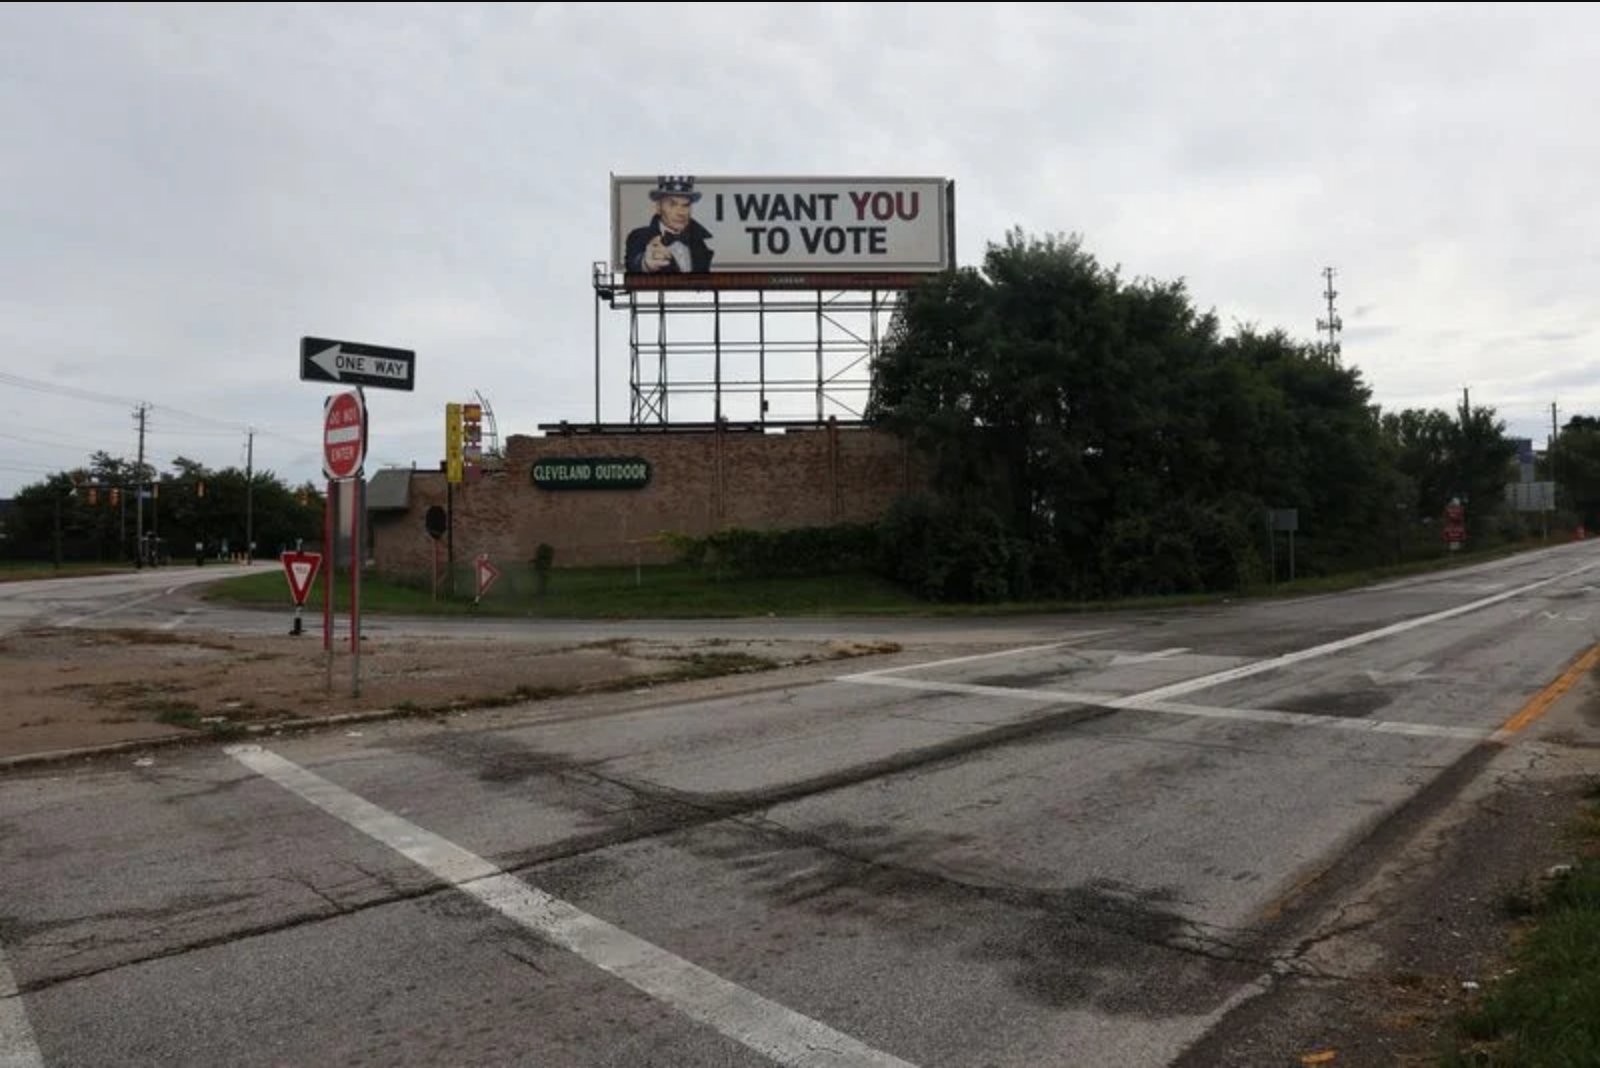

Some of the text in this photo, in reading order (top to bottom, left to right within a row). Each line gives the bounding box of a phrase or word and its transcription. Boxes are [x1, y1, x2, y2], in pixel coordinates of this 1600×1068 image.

[715, 191, 919, 221] I WANT YOU
[746, 227, 887, 255] TO VOTE
[335, 355, 404, 375] ONE WAY
[533, 464, 647, 481] CLEVELAND OUTDOOR
